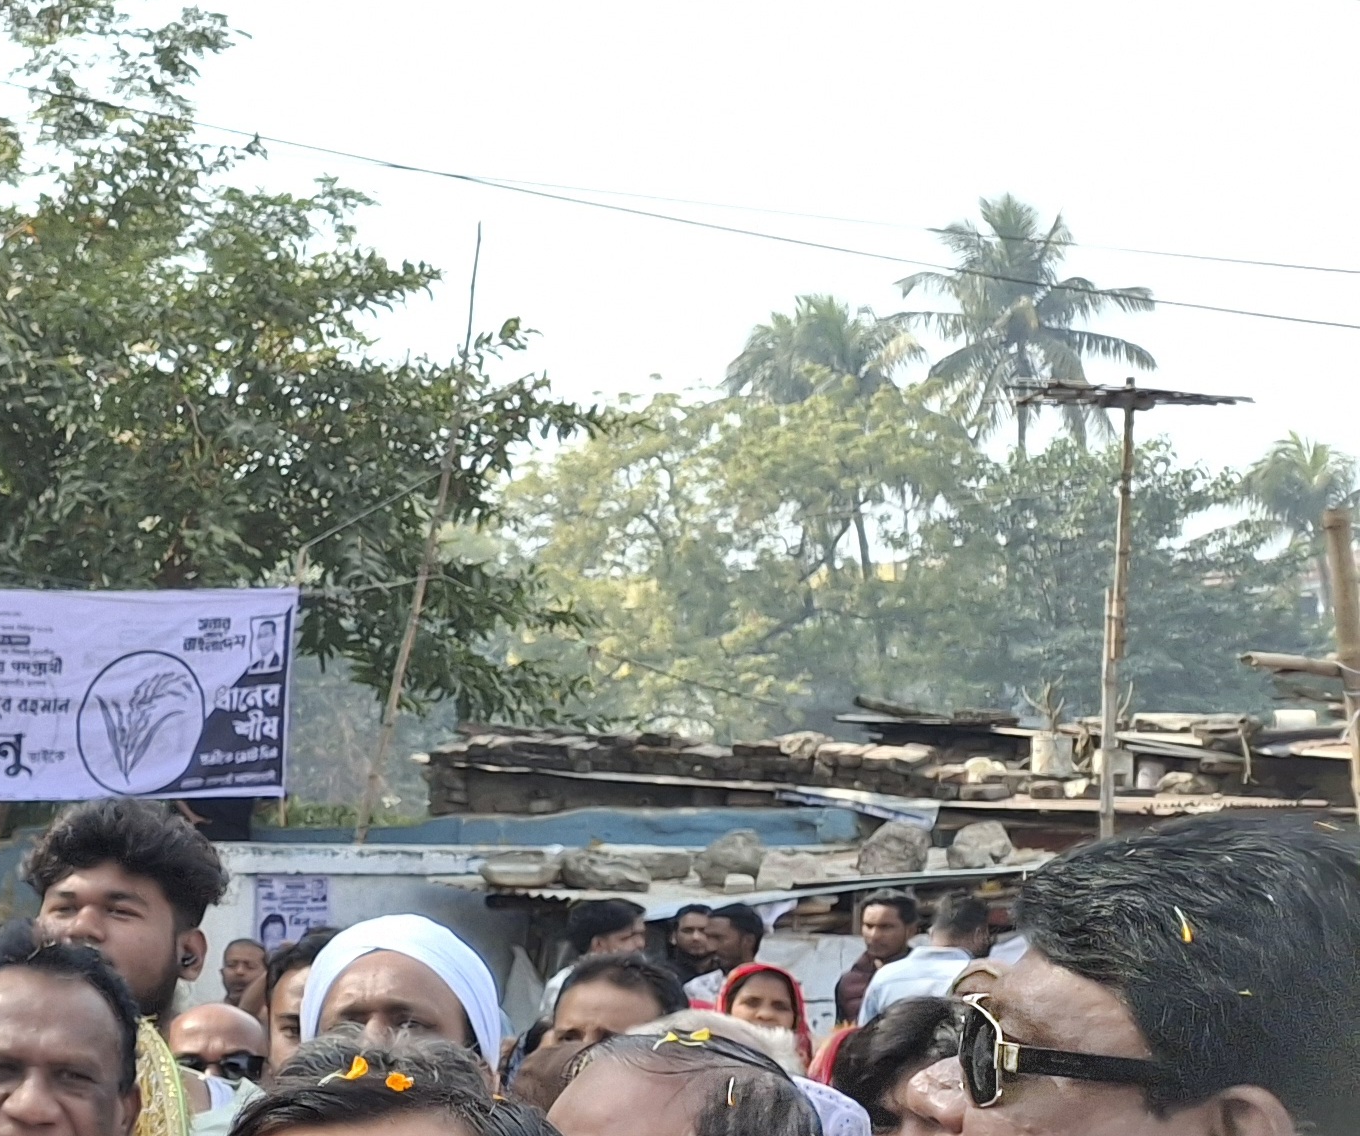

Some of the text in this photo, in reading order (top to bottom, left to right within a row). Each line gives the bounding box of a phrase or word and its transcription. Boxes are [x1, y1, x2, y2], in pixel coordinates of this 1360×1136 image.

[17, 697, 70, 715] রহমান
[214, 684, 282, 712] ধানের
[231, 708, 280, 743] শীষ
